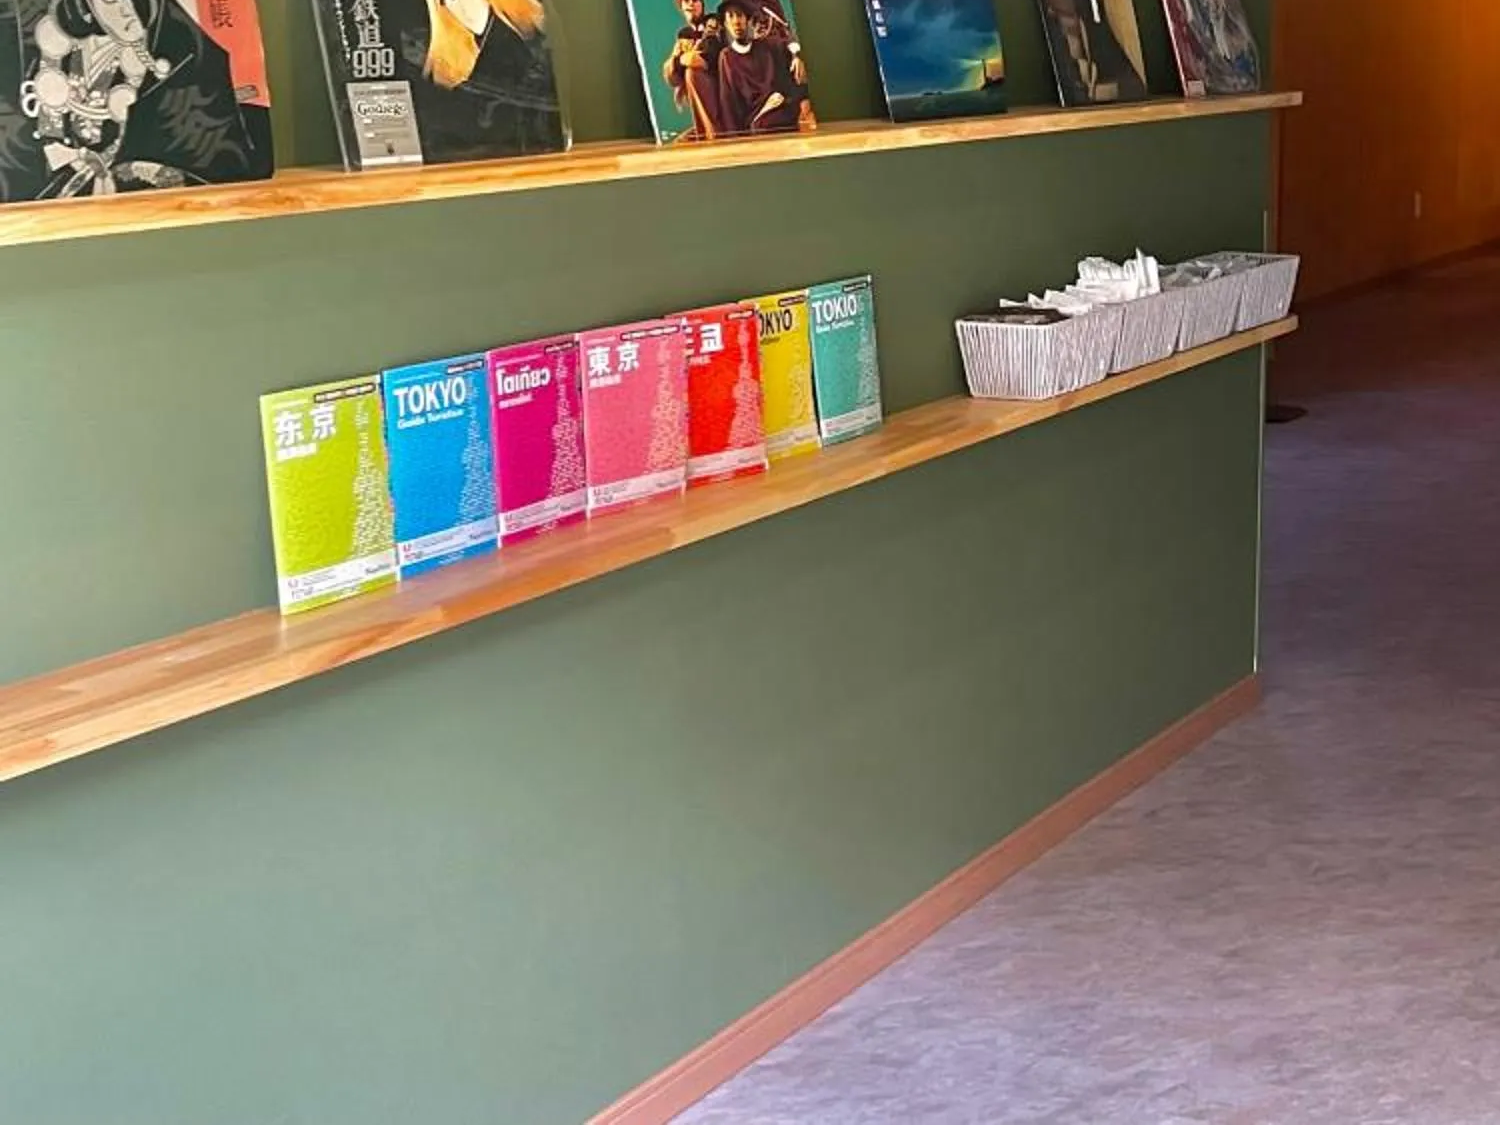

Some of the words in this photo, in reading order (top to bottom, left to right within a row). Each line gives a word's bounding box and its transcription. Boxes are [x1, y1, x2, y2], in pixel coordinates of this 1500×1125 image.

[352, 47, 395, 78] 999
[811, 294, 857, 324] TOKIO
[586, 340, 641, 377] 東京
[495, 364, 551, 396] โตเกียว
[392, 376, 466, 417] TOKYO
